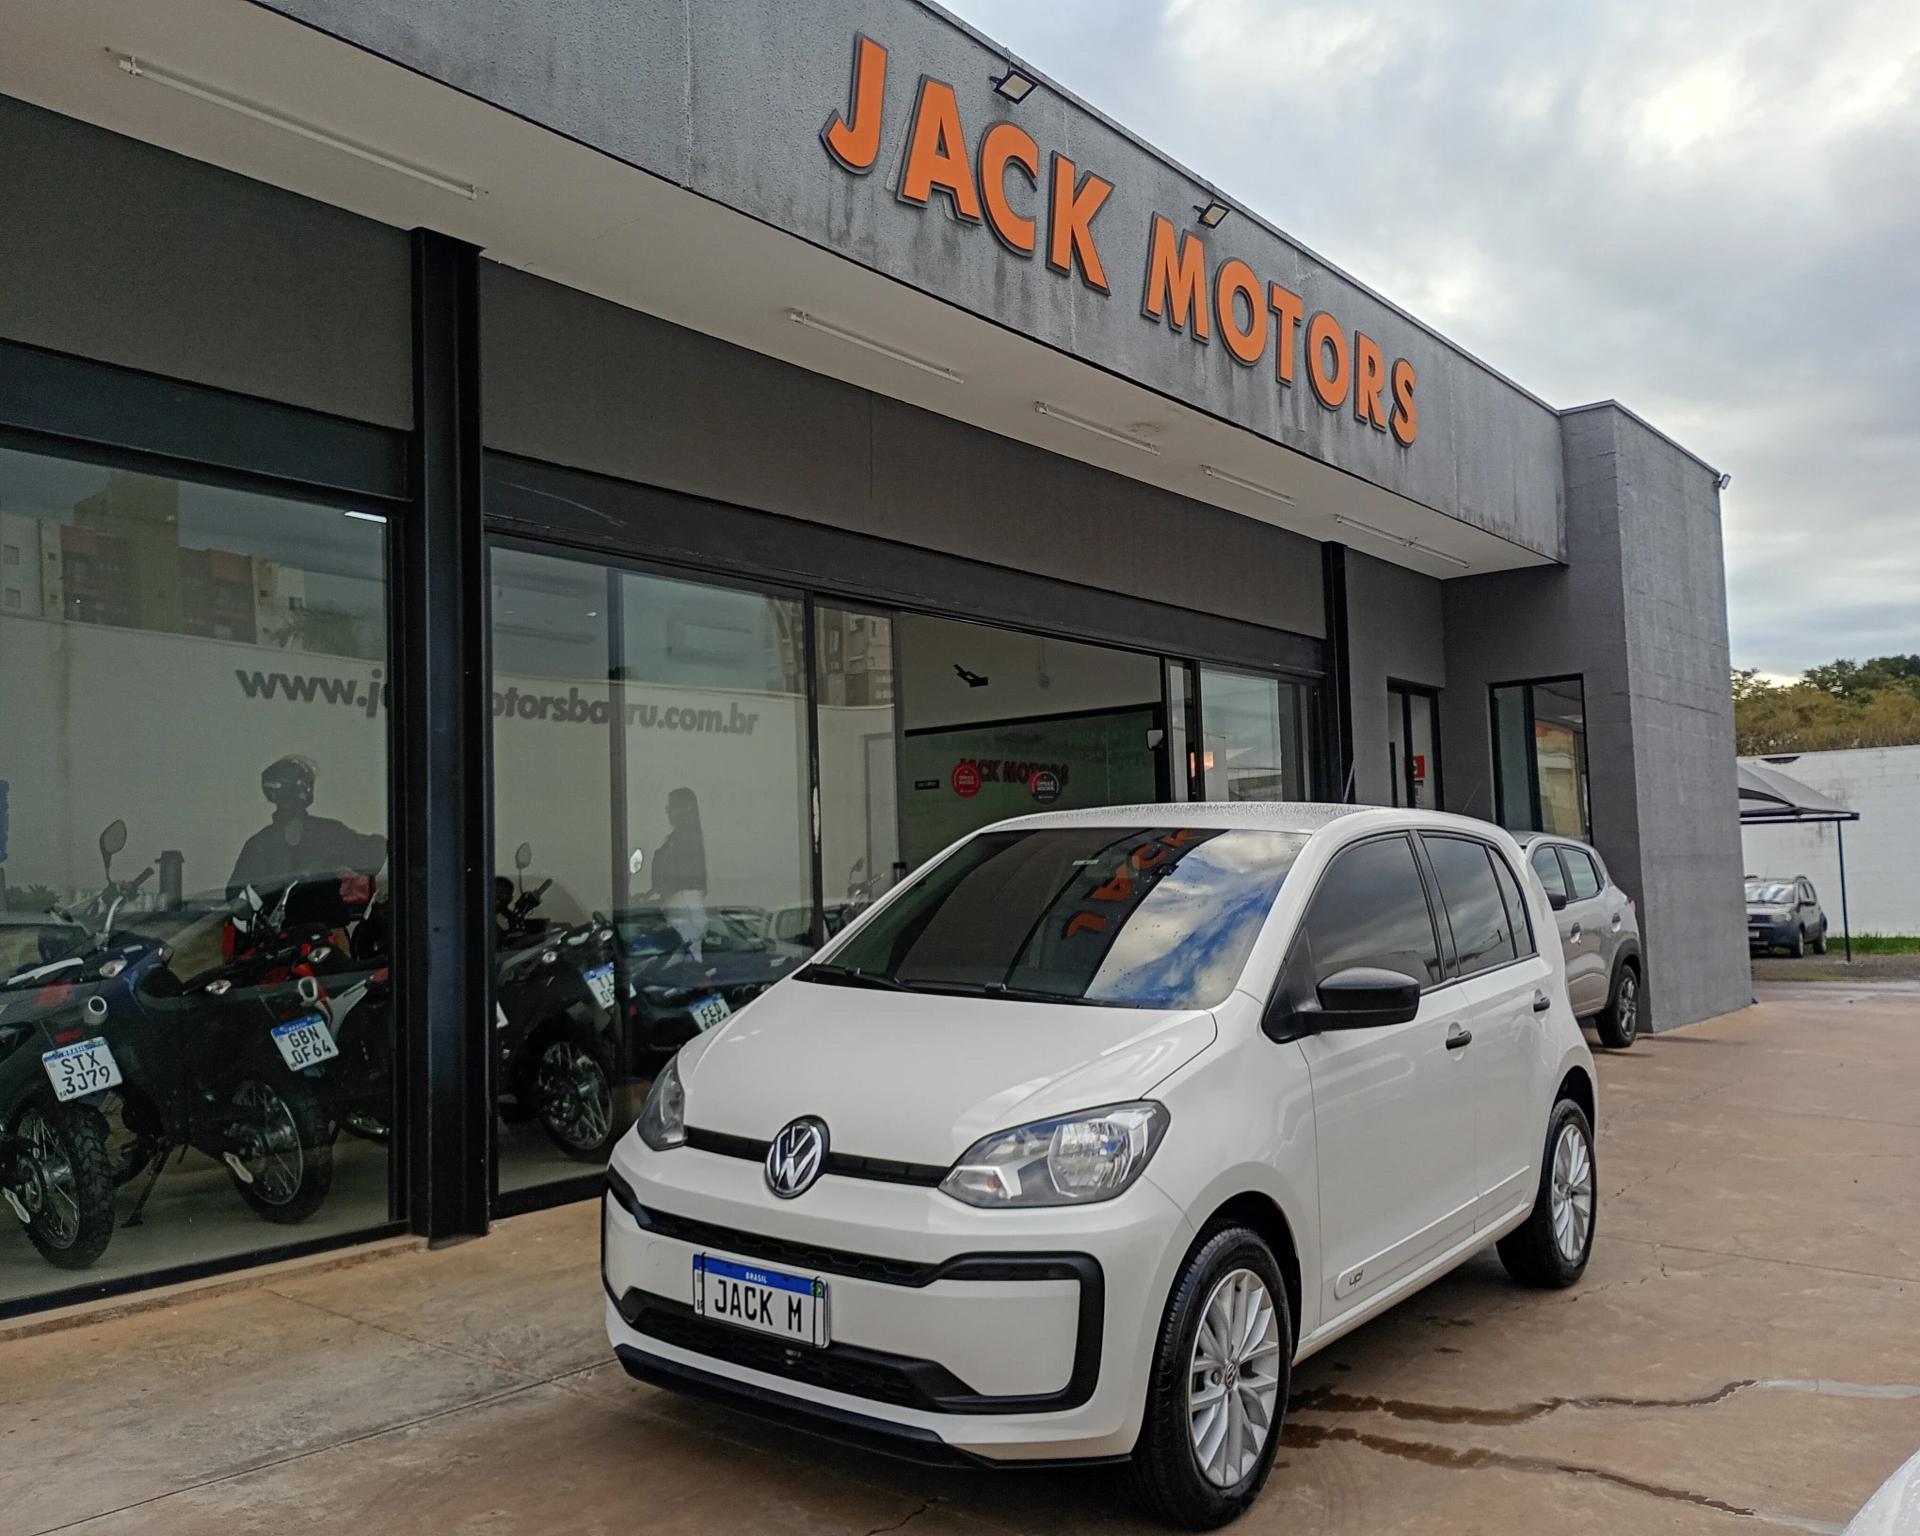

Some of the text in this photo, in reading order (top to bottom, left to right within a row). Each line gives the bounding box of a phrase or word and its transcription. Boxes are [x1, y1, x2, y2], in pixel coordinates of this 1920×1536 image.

[820, 33, 1418, 447] JACK MOTORS
[288, 1025, 320, 1048] GBN
[61, 1050, 100, 1075] STX
[61, 1065, 111, 1094] 3J79
[745, 1270, 768, 1284] BRASIL
[714, 1278, 802, 1333] JACK M
